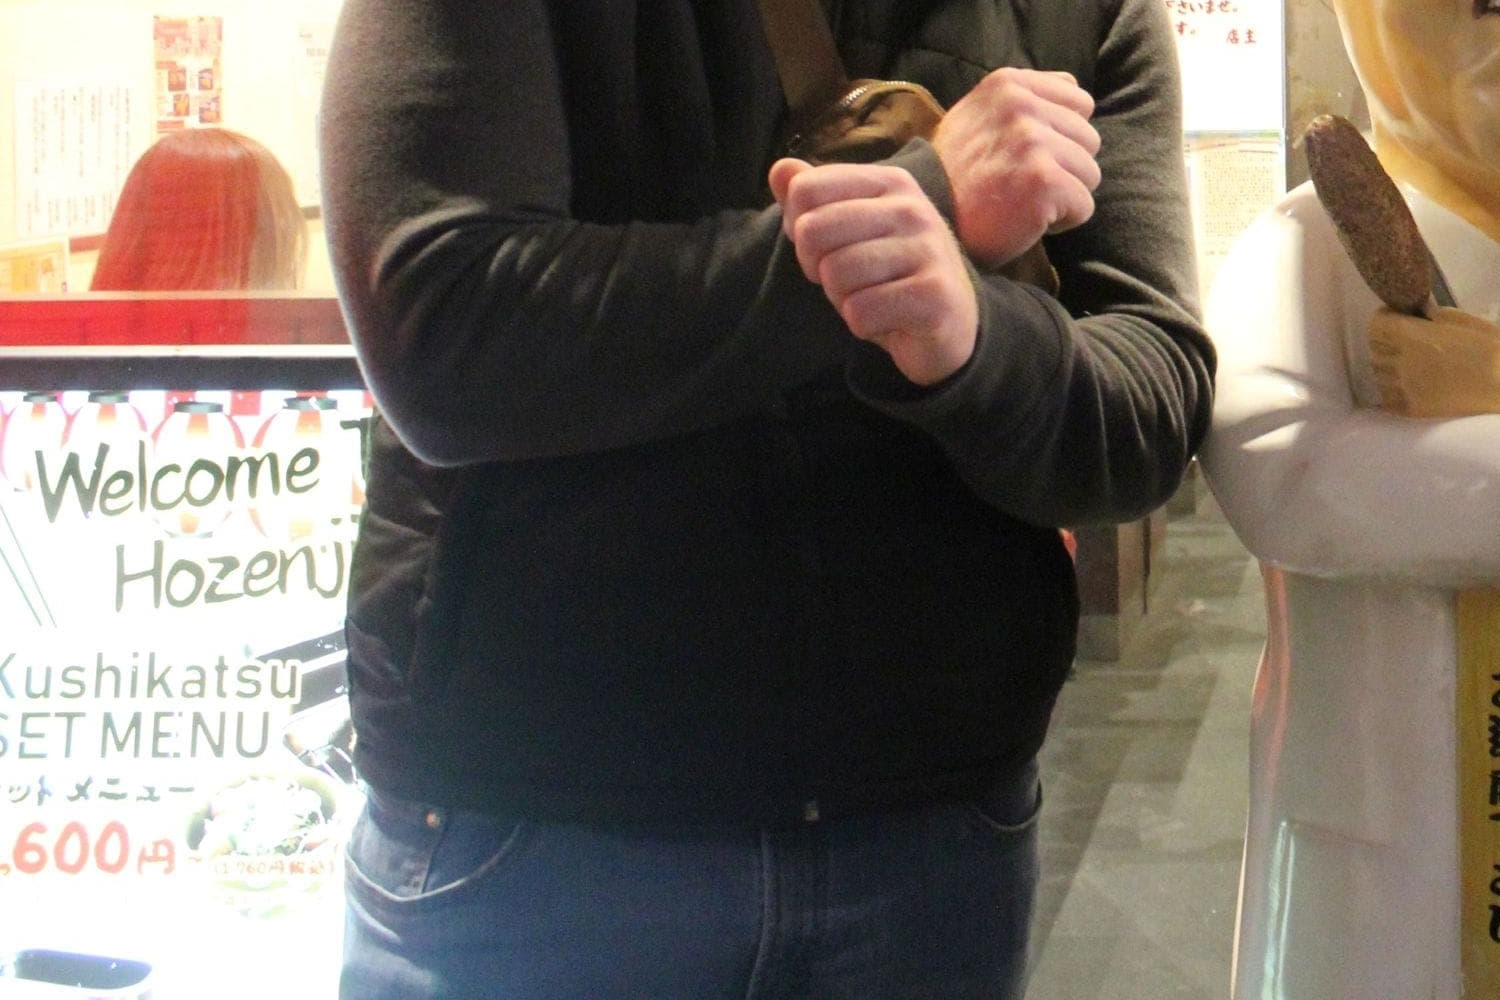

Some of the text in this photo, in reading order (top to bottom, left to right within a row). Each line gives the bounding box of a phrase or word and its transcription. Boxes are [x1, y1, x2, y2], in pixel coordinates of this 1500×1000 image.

[35, 440, 321, 523] Welcome
[115, 517, 358, 613] Hozenj
[100, 711, 270, 759] MENU
[0, 775, 195, 806] ットメニュー
